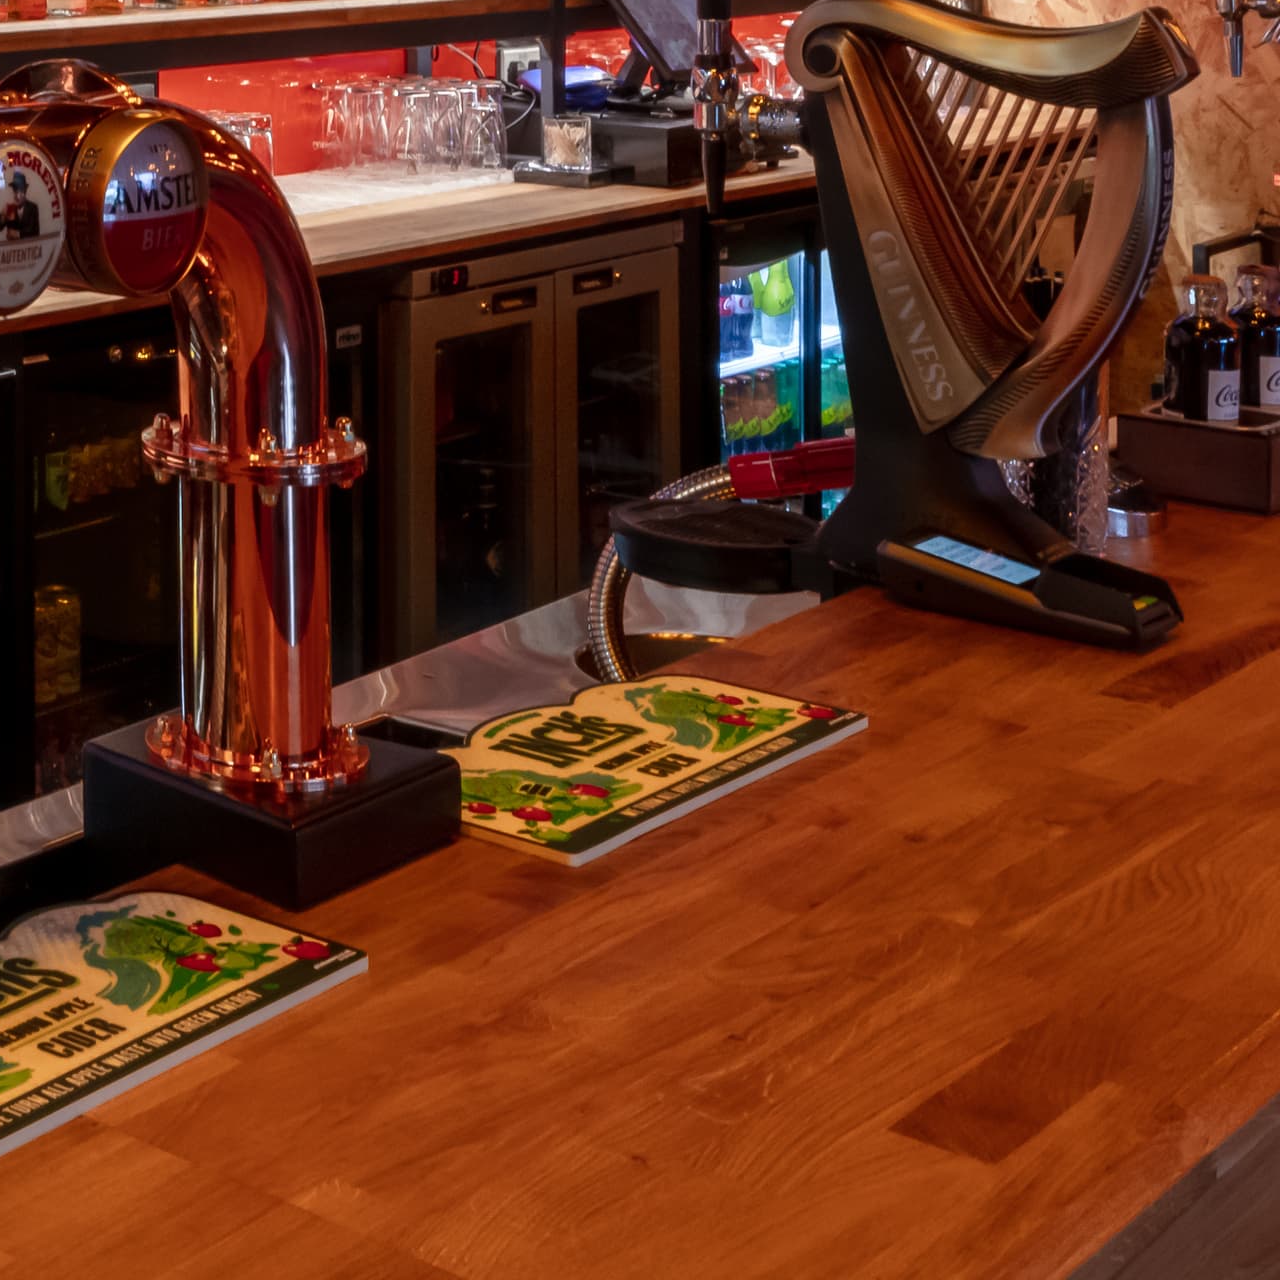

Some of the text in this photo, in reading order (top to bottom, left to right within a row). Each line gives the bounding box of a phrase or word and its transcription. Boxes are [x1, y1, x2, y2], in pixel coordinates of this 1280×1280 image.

[867, 229, 954, 402] GUINNESS
[36, 1017, 128, 1059] CIDER
[40, 1081, 69, 1111] ALL
[66, 1060, 112, 1101] APPLE
[107, 1041, 153, 1080] WASTE
[145, 1024, 183, 1057] INTO
[176, 1008, 220, 1043] GREEN
[210, 987, 264, 1024] ENERGY
